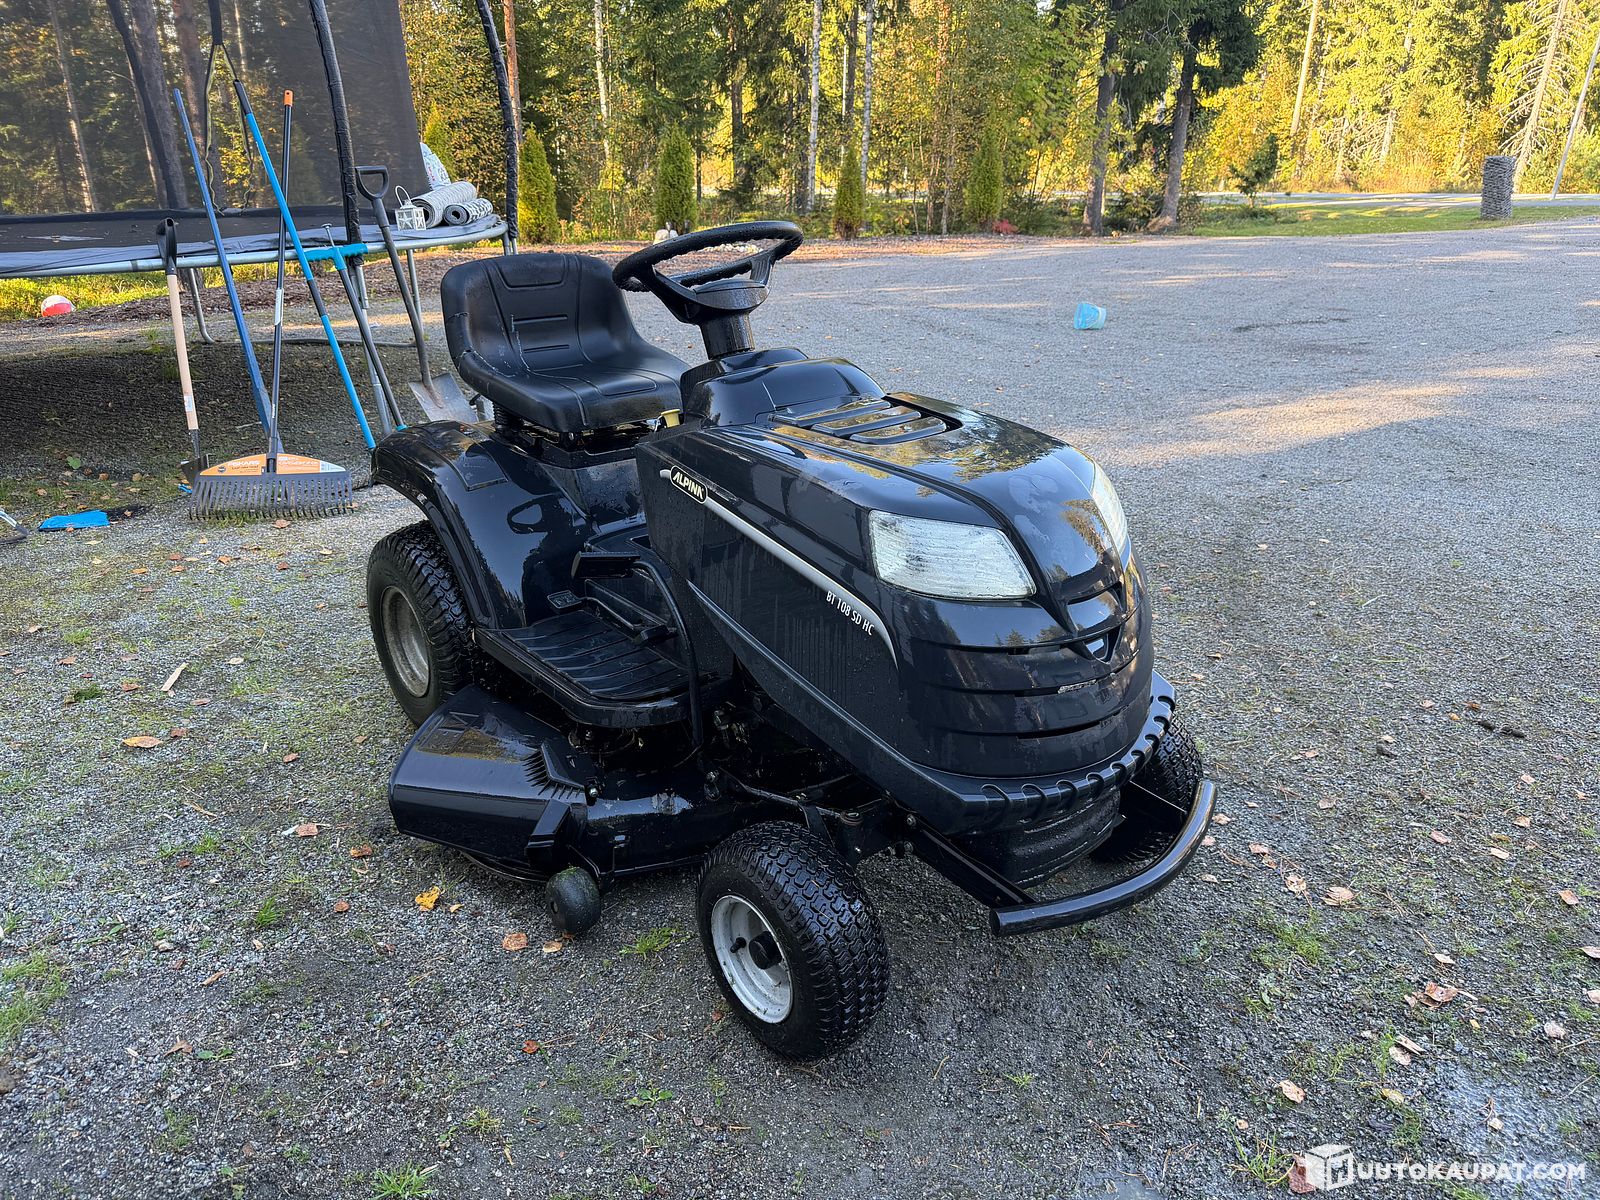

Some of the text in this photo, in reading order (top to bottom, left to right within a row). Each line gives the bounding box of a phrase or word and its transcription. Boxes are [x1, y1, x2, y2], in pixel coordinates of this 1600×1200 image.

[673, 471, 704, 500] ALPINA
[826, 590, 875, 636] BT 108 SD HC
